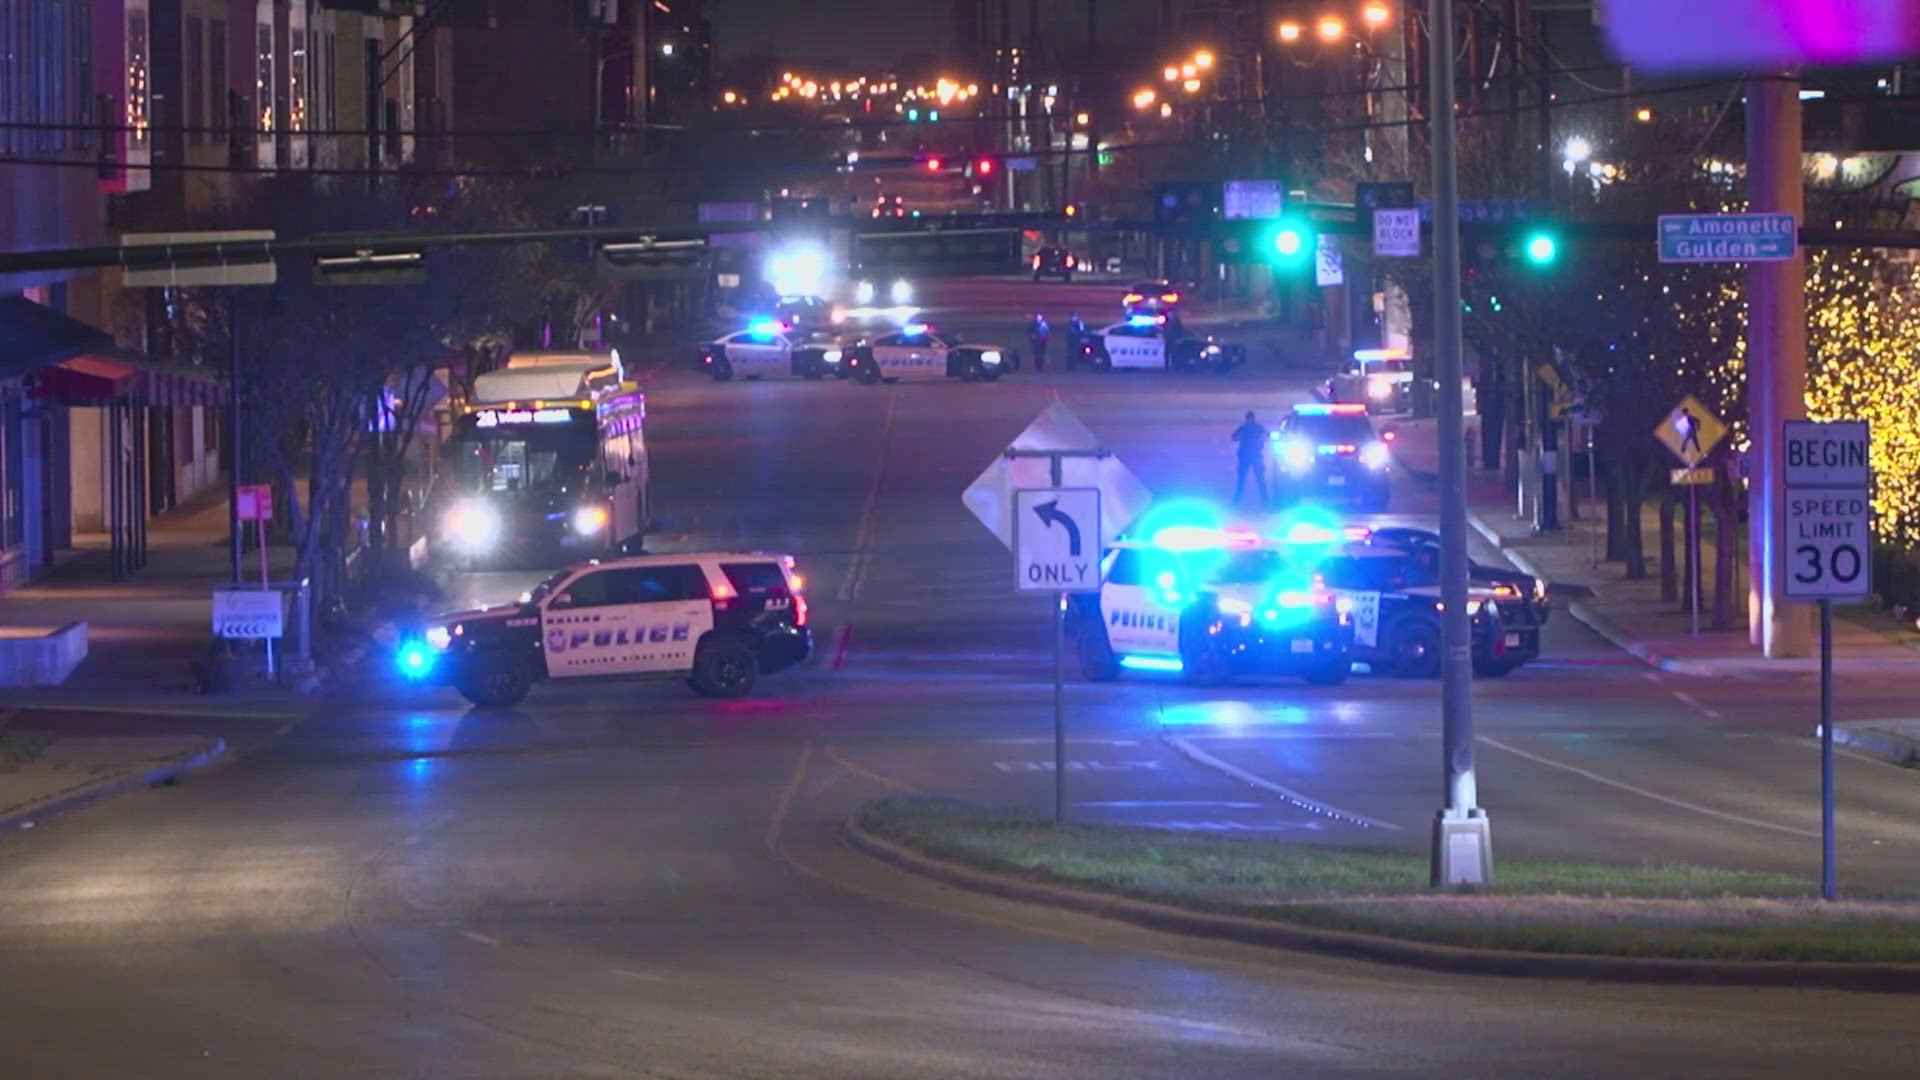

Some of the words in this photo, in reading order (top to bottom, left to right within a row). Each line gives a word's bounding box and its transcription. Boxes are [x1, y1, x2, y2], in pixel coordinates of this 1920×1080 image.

[1689, 218, 1792, 235] Amonette
[1676, 240, 1757, 257] Gulden
[1789, 439, 1865, 468] BEGIN
[1791, 500, 1863, 517] SPEED
[1799, 522, 1853, 539] LIMIT
[1028, 563, 1089, 583] ONLY
[1794, 544, 1862, 584] 30
[1111, 609, 1166, 630] POLICE
[569, 622, 691, 649] POLICE
